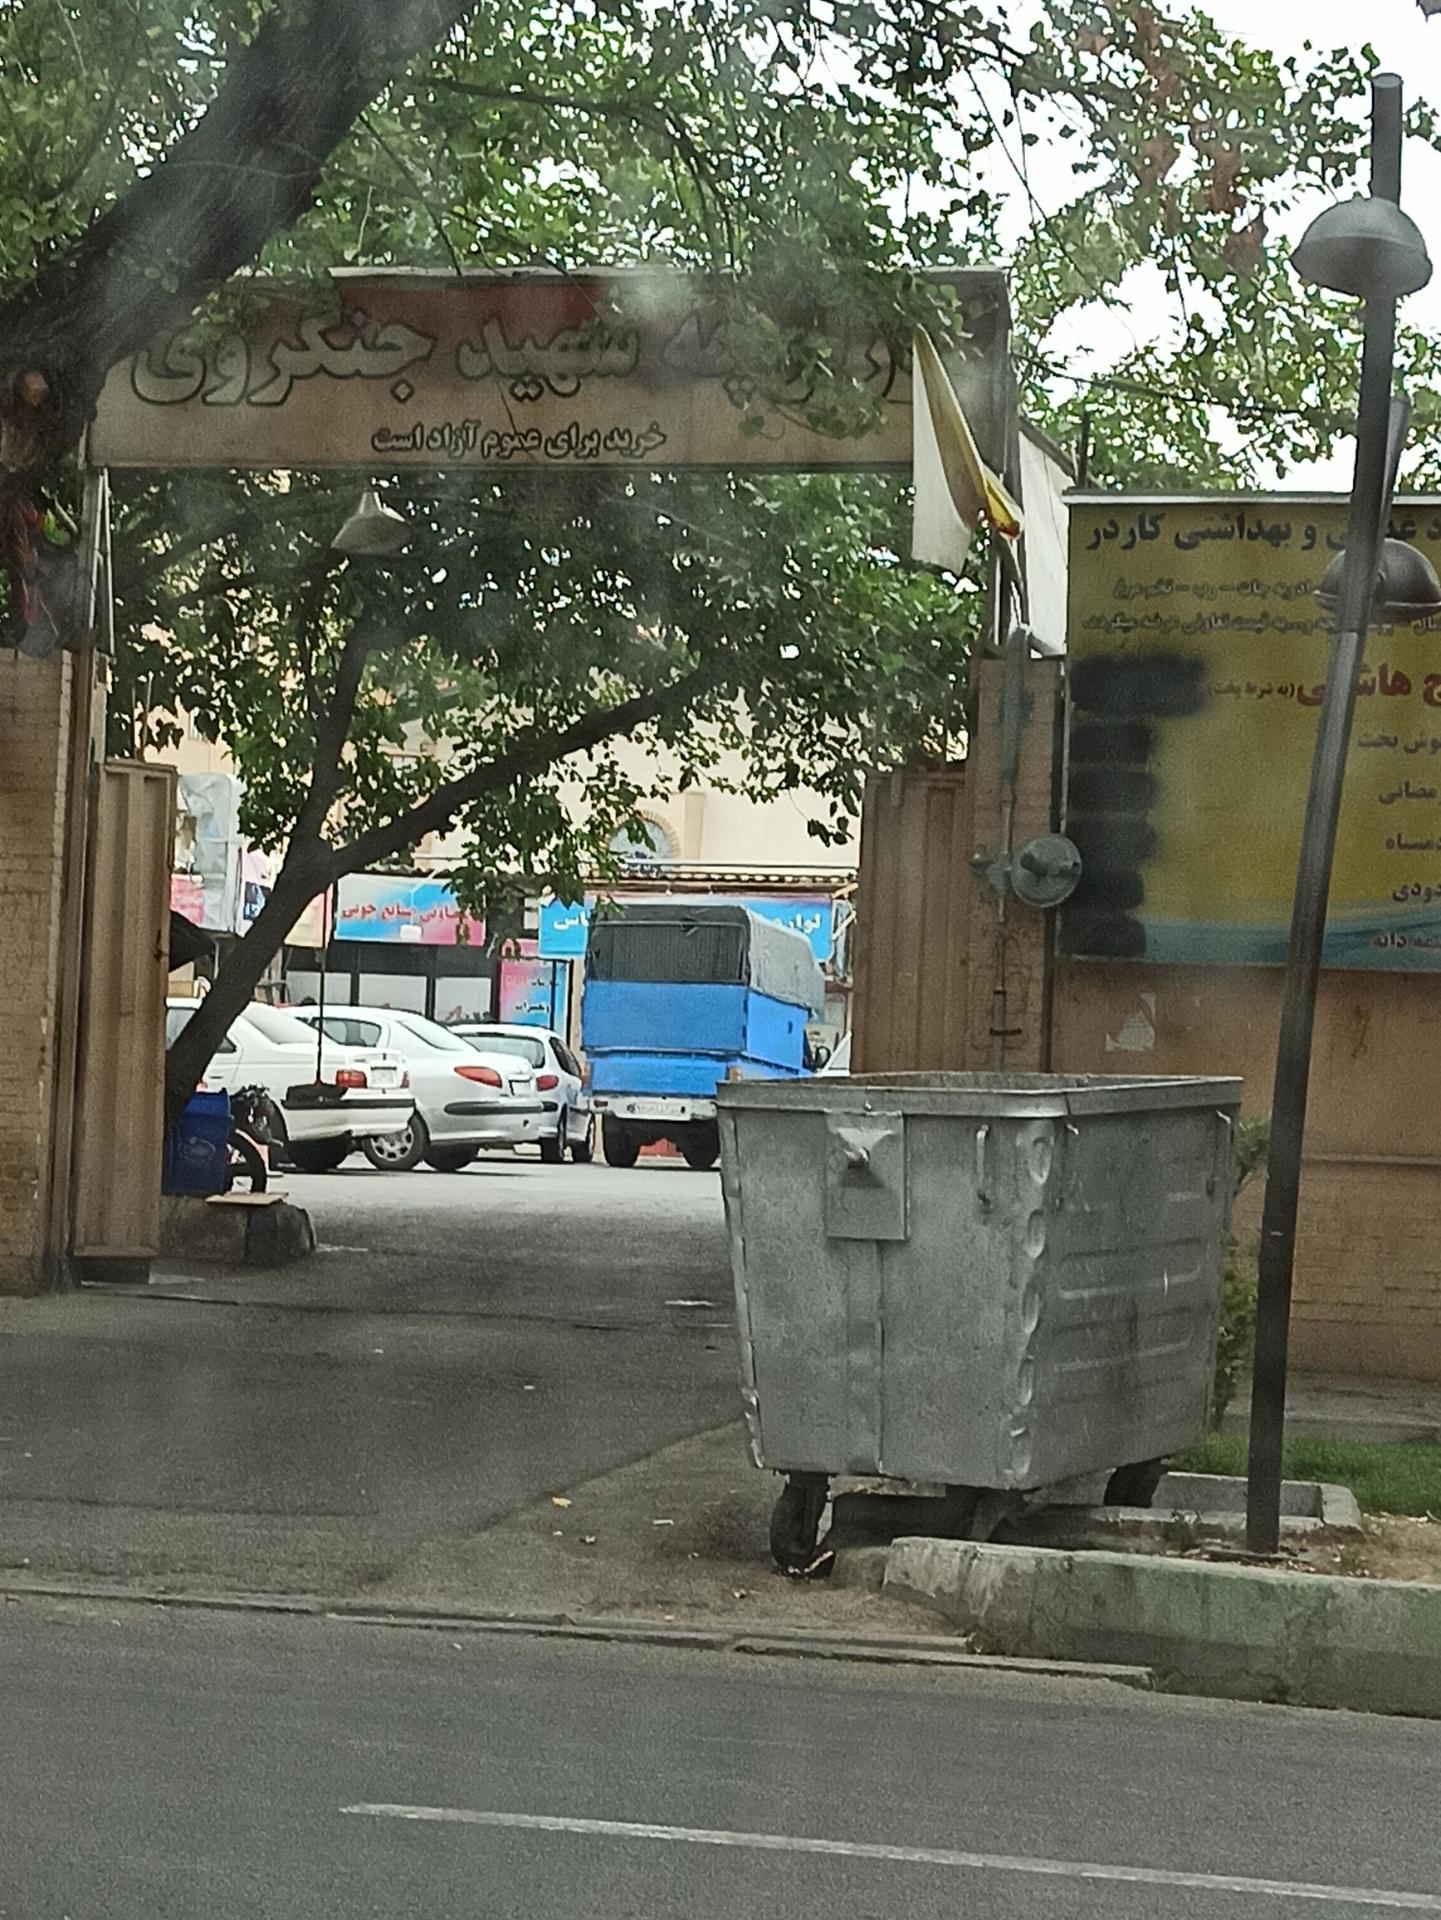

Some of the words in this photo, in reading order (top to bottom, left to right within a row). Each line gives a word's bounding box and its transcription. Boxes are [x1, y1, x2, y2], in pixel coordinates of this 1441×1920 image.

[372, 420, 423, 451] است
[426, 419, 481, 458] آزاد
[481, 427, 542, 459] عموم
[545, 420, 600, 459] برای
[604, 421, 667, 458] خرید
[1174, 511, 1293, 551] بهداشتی
[1296, 660, 1411, 707] هاشی
